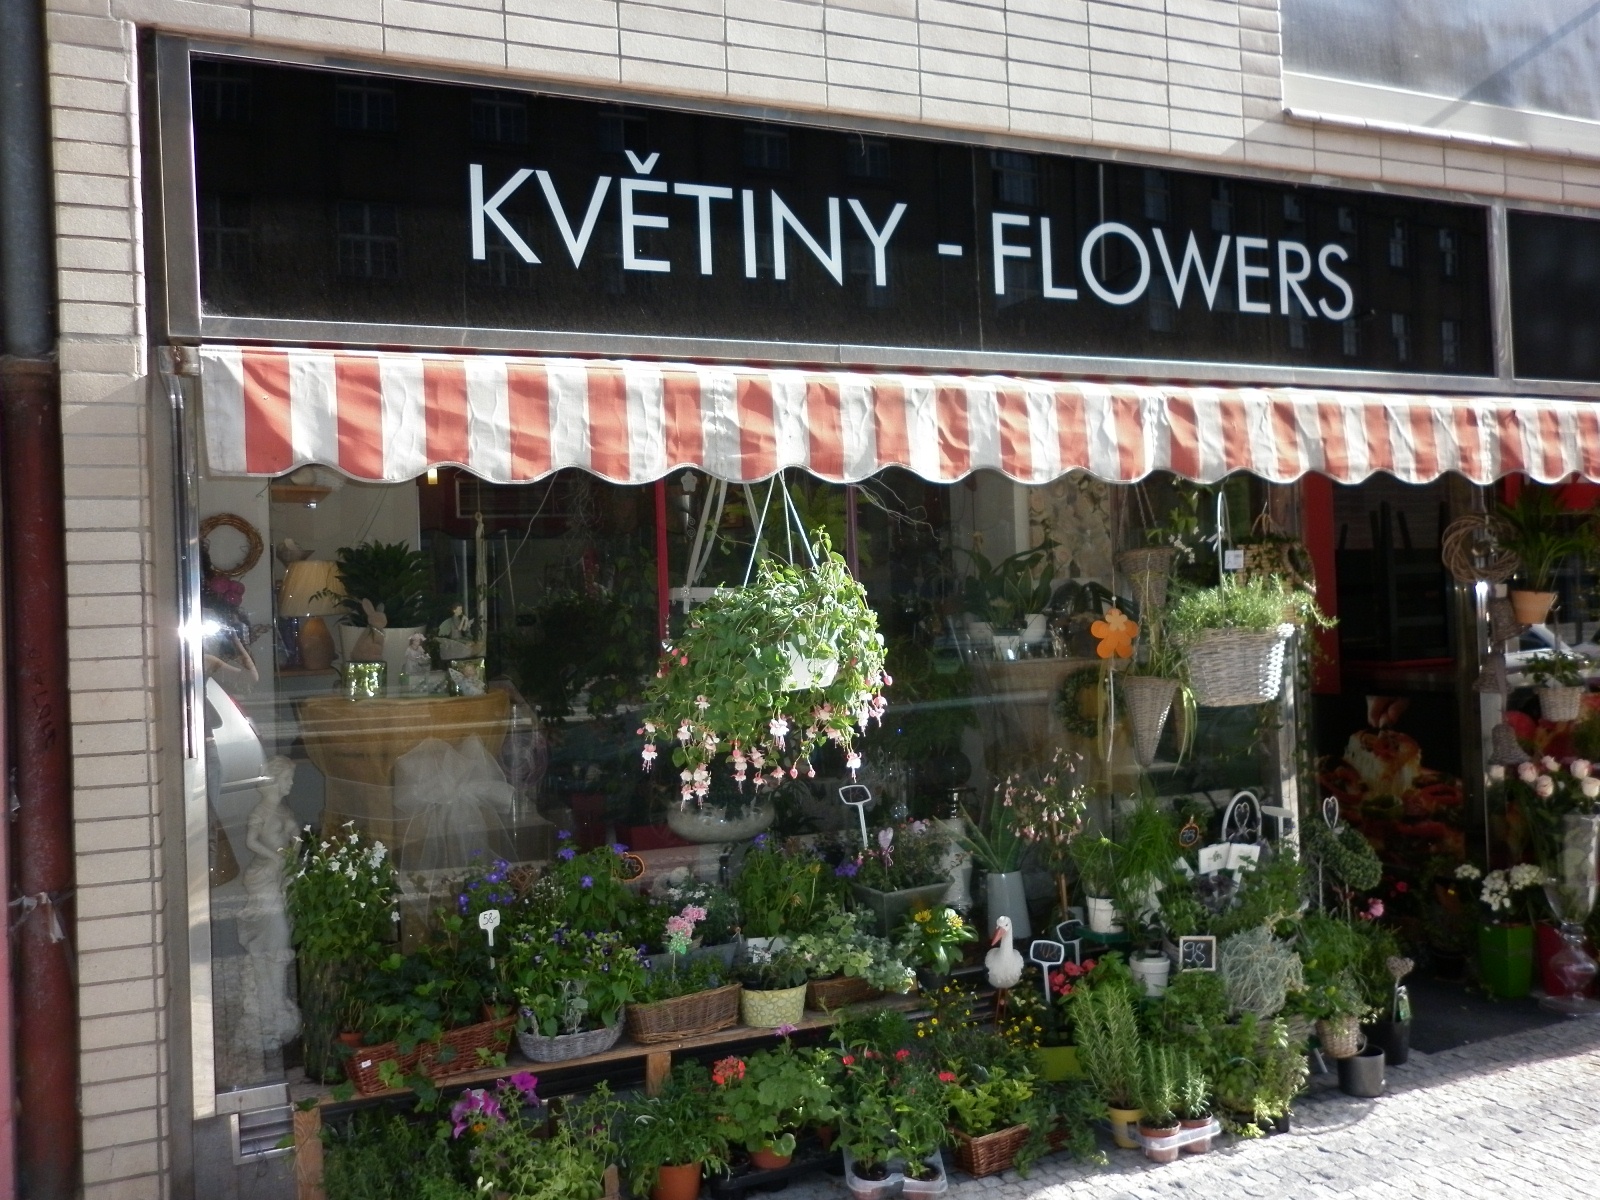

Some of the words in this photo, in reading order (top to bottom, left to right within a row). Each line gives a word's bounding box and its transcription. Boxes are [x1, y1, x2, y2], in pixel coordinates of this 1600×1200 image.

[469, 150, 907, 286] KVĚTINY
[938, 244, 963, 256] -
[992, 212, 1354, 321] FLOWERS
[1183, 941, 1206, 963] 98
